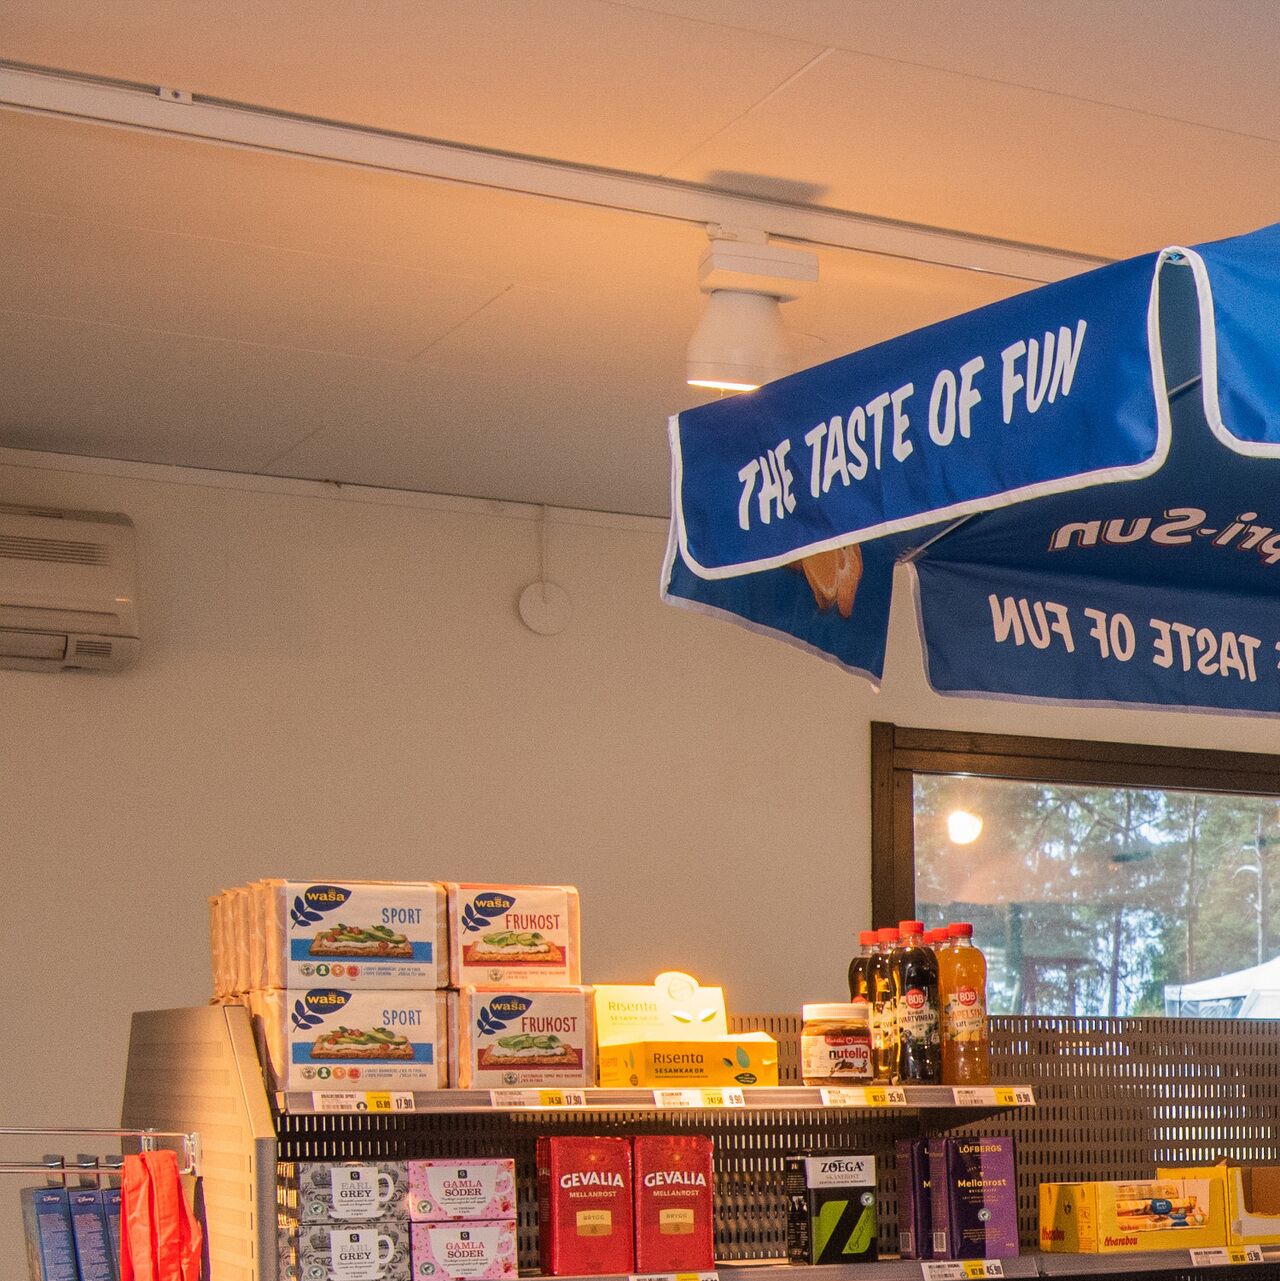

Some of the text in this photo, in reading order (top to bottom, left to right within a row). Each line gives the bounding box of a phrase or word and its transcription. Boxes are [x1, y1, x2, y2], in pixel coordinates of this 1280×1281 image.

[738, 320, 1088, 530] THE TASTE OF FUN
[307, 890, 345, 902] wasa
[475, 897, 510, 909] wasa
[381, 908, 422, 924] SPORT
[505, 914, 560, 930] FRUKOST
[307, 993, 345, 1005] wasa
[908, 995, 924, 1003] BOB
[959, 992, 975, 1000] BOB
[491, 1001, 527, 1012] wasa
[382, 1010, 422, 1026] SPORT
[521, 1016, 577, 1033] FRUKOST
[652, 1052, 704, 1065] Risenta
[829, 1048, 868, 1060] nutella
[442, 1179, 483, 1189] GAMLA
[560, 1172, 624, 1189] GEVALIA
[644, 1171, 706, 1188] GEVALIA
[957, 1178, 1006, 1188] Mellanrost
[340, 1190, 373, 1199] GREY
[444, 1187, 482, 1197] SÖDER
[569, 1190, 616, 1198] MELLANROST
[653, 1189, 700, 1197] MELLANROST
[445, 1241, 485, 1250] GAMLA
[1104, 1236, 1138, 1247] Marabou
[339, 1251, 372, 1260] GREY
[447, 1248, 484, 1258] SÖDER
